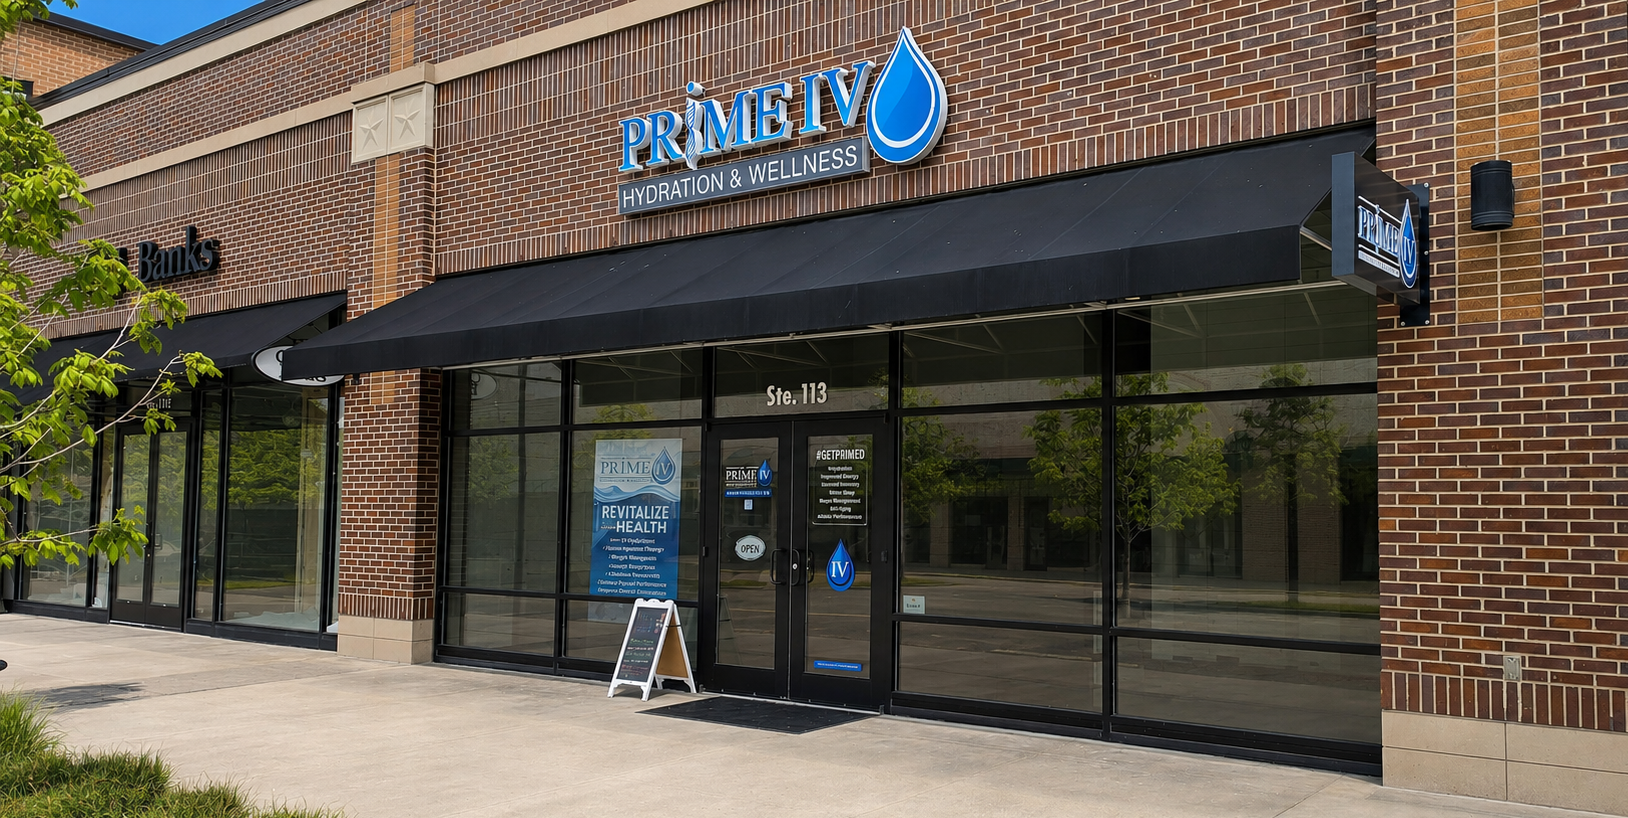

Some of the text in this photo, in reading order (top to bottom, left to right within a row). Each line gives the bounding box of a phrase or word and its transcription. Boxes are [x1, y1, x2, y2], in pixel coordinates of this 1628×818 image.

[618, 60, 875, 171] PRIME IV
[622, 145, 858, 208] HYDRATION & WELLNESS
[1358, 204, 1400, 258] PRIME
[1403, 236, 1415, 264] IV
[138, 225, 219, 283] Banks
[766, 381, 828, 407] Ste. 113
[816, 448, 866, 461] #GETPRIMED
[600, 457, 671, 476] PRIME IV
[725, 467, 771, 481] PRIME IV
[602, 505, 670, 519] REVITALIZE
[616, 520, 667, 534] HEALTH
[740, 544, 760, 554] OPEN
[831, 561, 849, 578] IV
